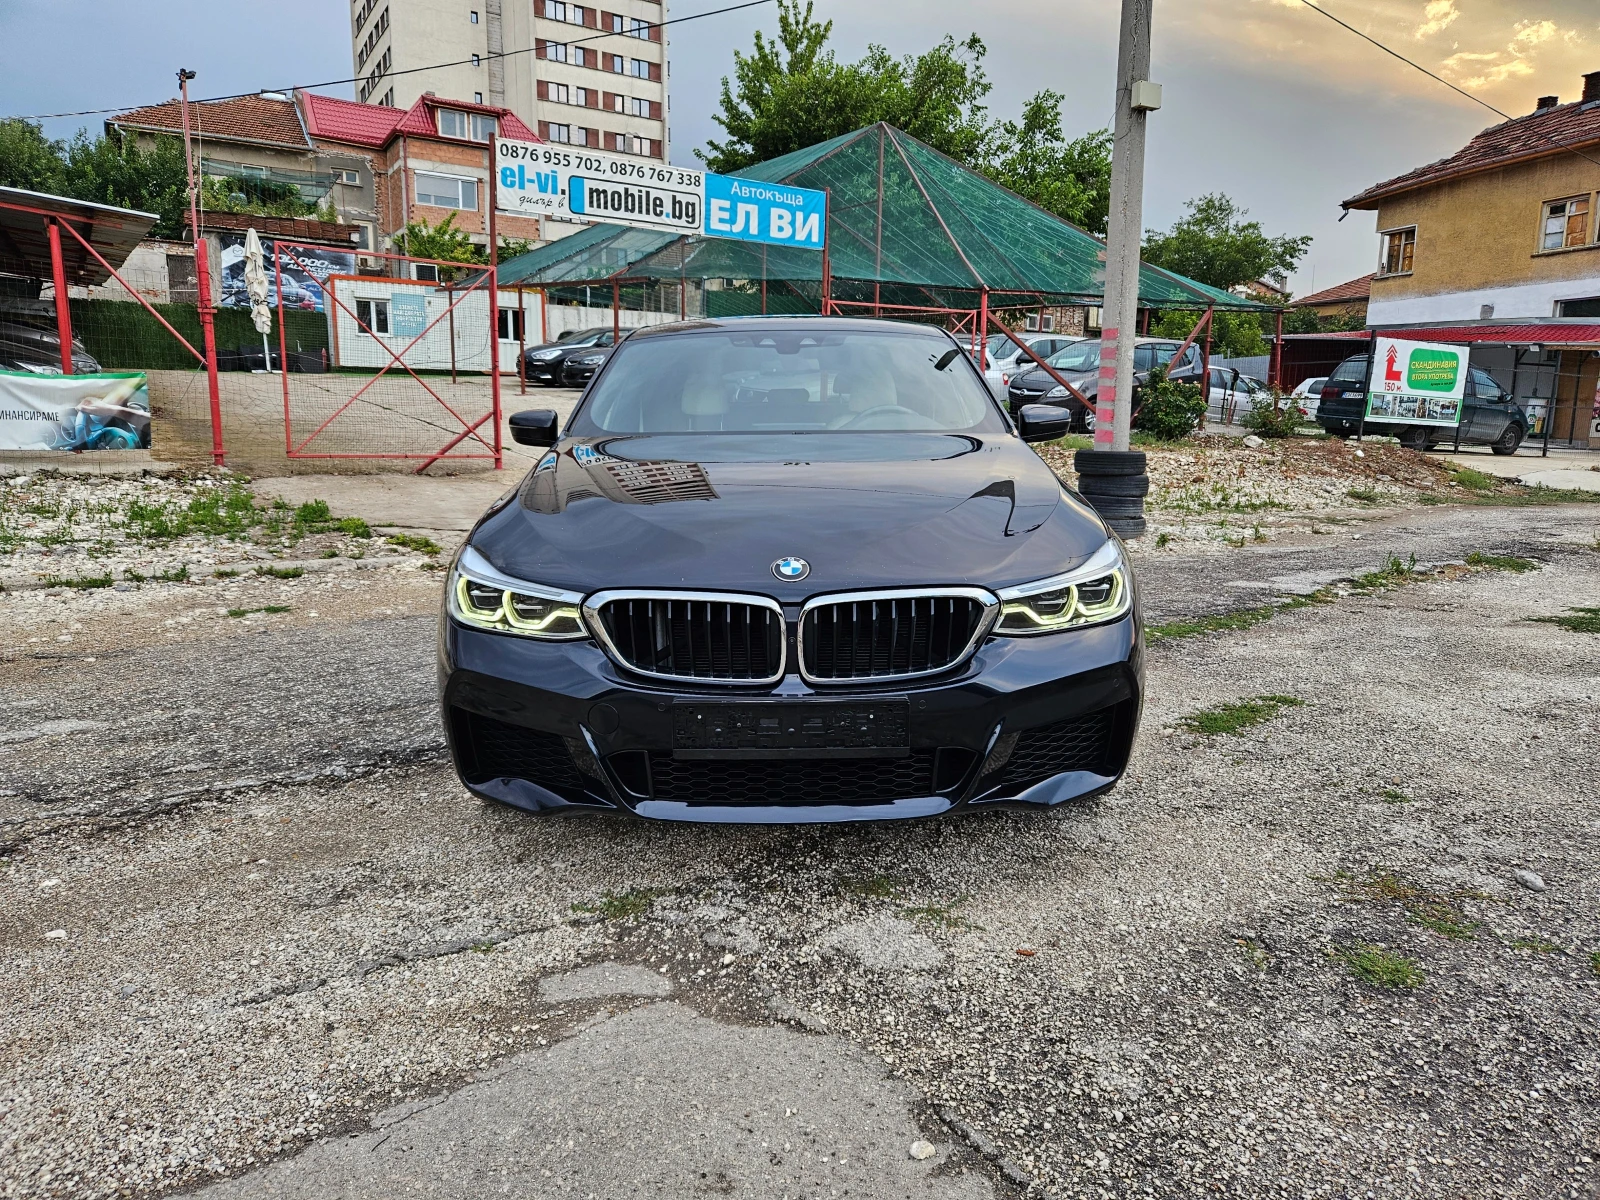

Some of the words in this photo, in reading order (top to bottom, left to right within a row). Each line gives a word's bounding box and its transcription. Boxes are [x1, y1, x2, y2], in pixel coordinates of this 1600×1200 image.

[500, 143, 539, 162] 0876
[543, 150, 571, 167] 955
[574, 155, 606, 174] 702,
[610, 161, 645, 179] 0876
[648, 167, 673, 183] 767
[677, 172, 701, 187] 338
[588, 186, 696, 225] mobile.bg
[730, 181, 803, 207] Автокъща
[710, 197, 759, 236] ЕЛ
[769, 206, 820, 243] ВИ
[1410, 360, 1457, 370] СКАНДИНАВИЯ
[1411, 373, 1428, 381] ВТОРА
[1428, 372, 1454, 380] УПОТРЕБА
[1384, 381, 1396, 392] 150
